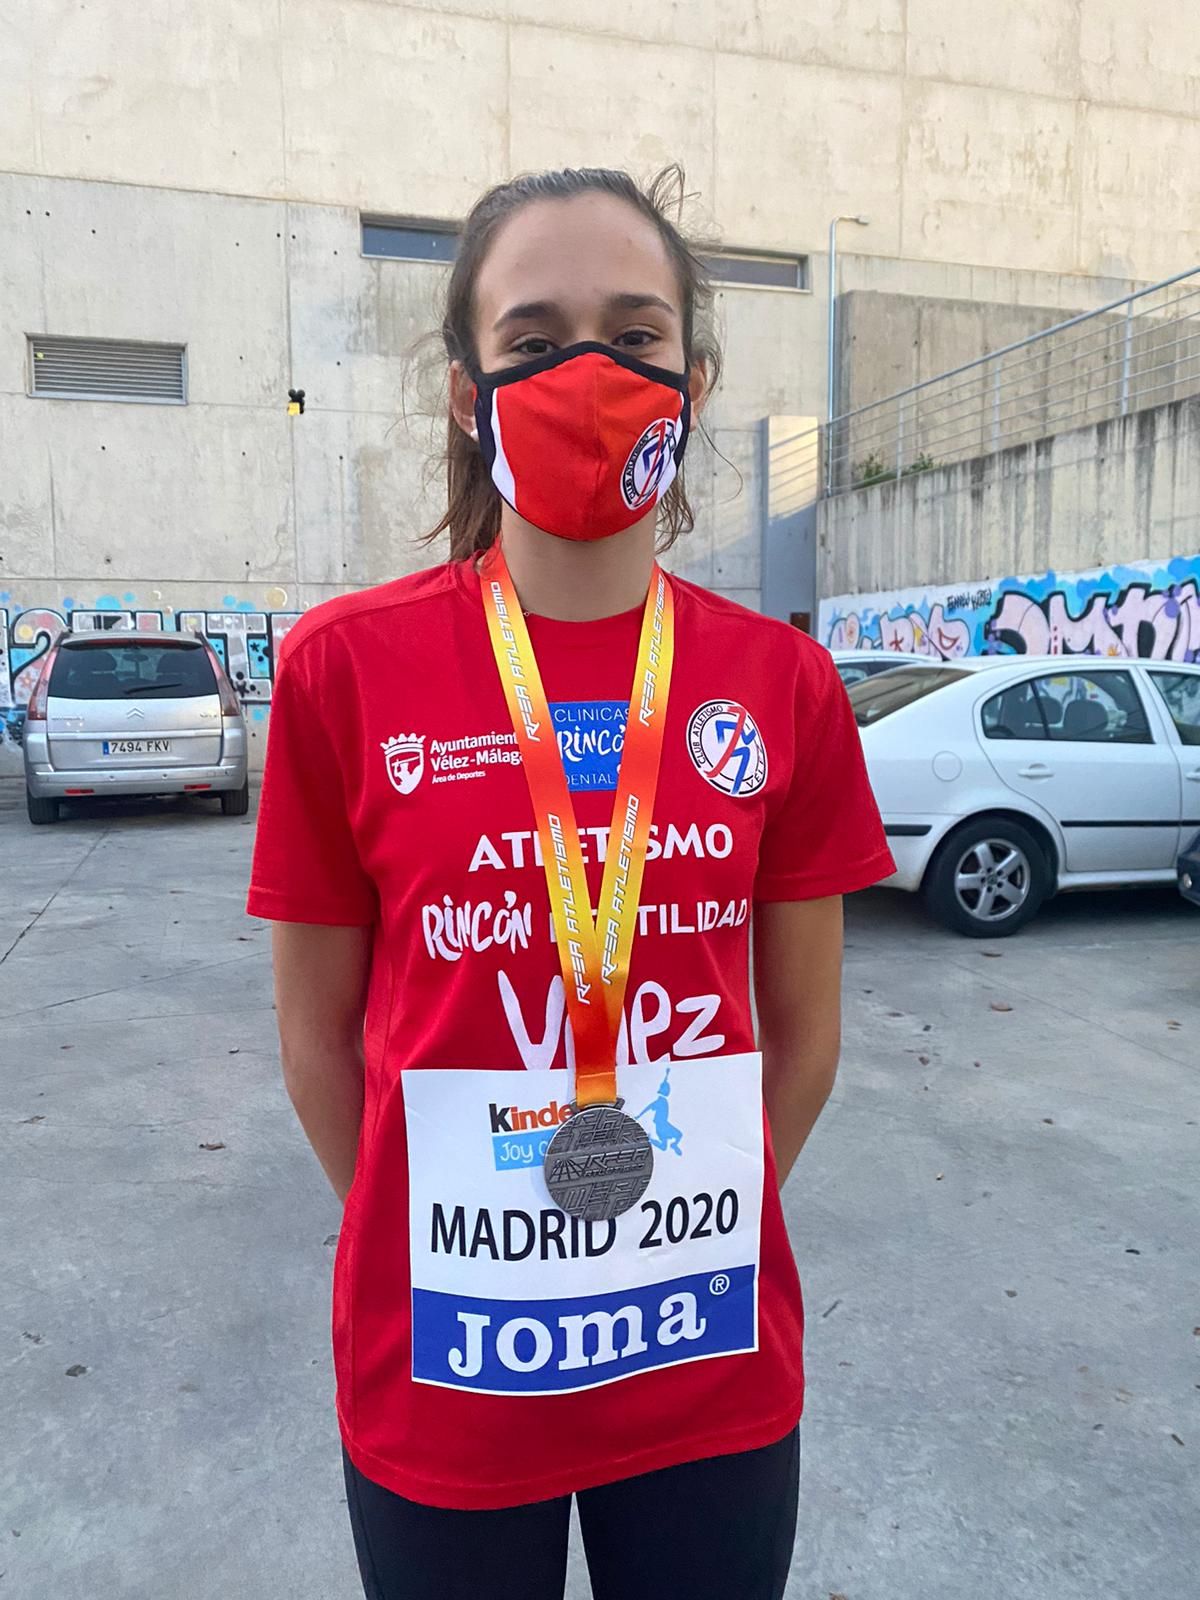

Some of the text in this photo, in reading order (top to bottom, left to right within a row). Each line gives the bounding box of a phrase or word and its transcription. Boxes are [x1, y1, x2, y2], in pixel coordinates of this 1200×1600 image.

[490, 581, 525, 679] ATLETISMO
[648, 573, 666, 667] ATLETISMO
[111, 741, 170, 753] 7494 FKV
[429, 731, 519, 756] Ayuntamient
[692, 704, 724, 765] CLUB ATLETISMO
[447, 773, 456, 781] de
[456, 770, 486, 780] Deportes
[468, 822, 734, 872] ATETSMO
[547, 813, 591, 1005] RFEA ATLETISMO
[601, 793, 640, 985] RFEA ATLETISMO
[549, 898, 748, 944] TILIDAD
[500, 1141, 534, 1164] Joy
[430, 1188, 739, 1262] MADRID 2020
